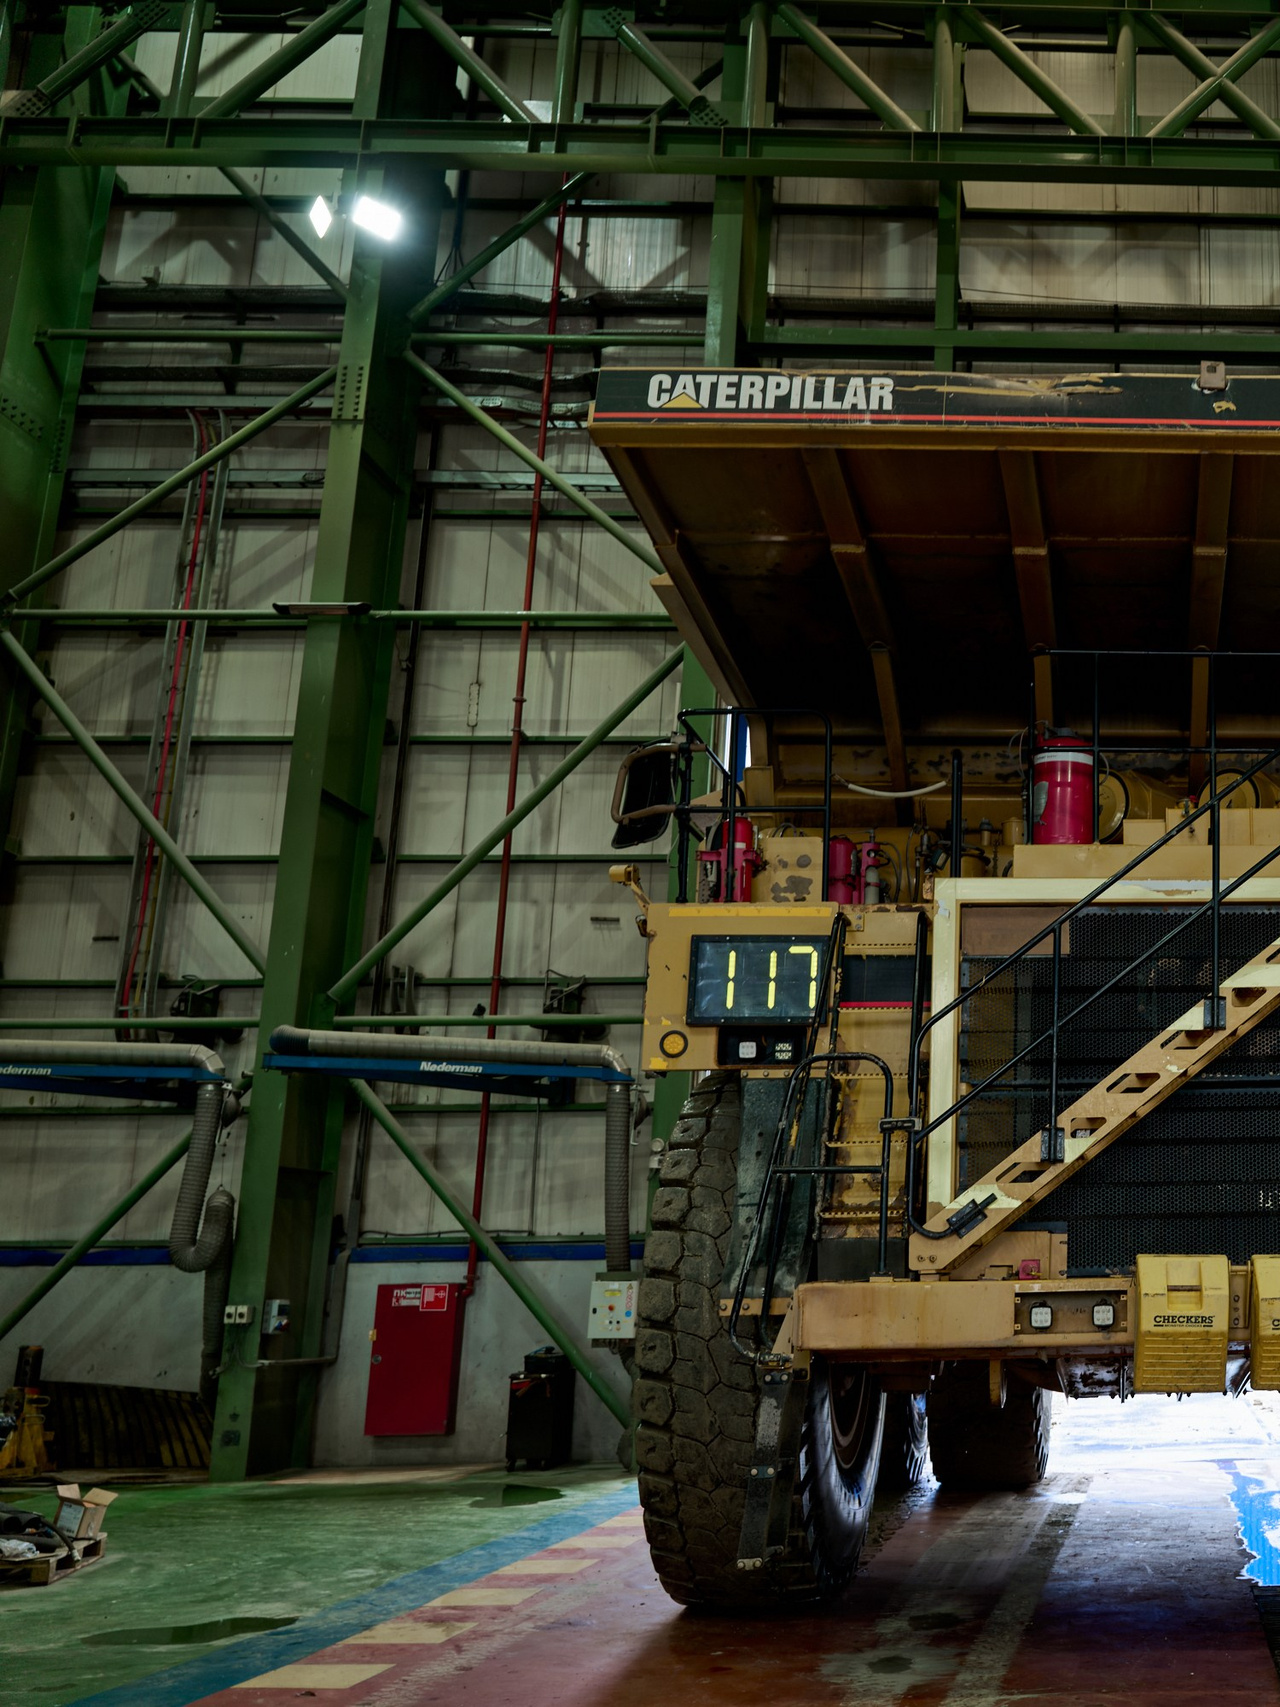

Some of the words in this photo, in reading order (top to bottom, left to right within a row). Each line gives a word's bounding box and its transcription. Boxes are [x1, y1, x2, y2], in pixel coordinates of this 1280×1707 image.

[647, 373, 895, 411] CATERPILLAR
[725, 945, 818, 1010] 117
[420, 1061, 483, 1073] Nederman
[1153, 1315, 1213, 1324] CHECKERS
